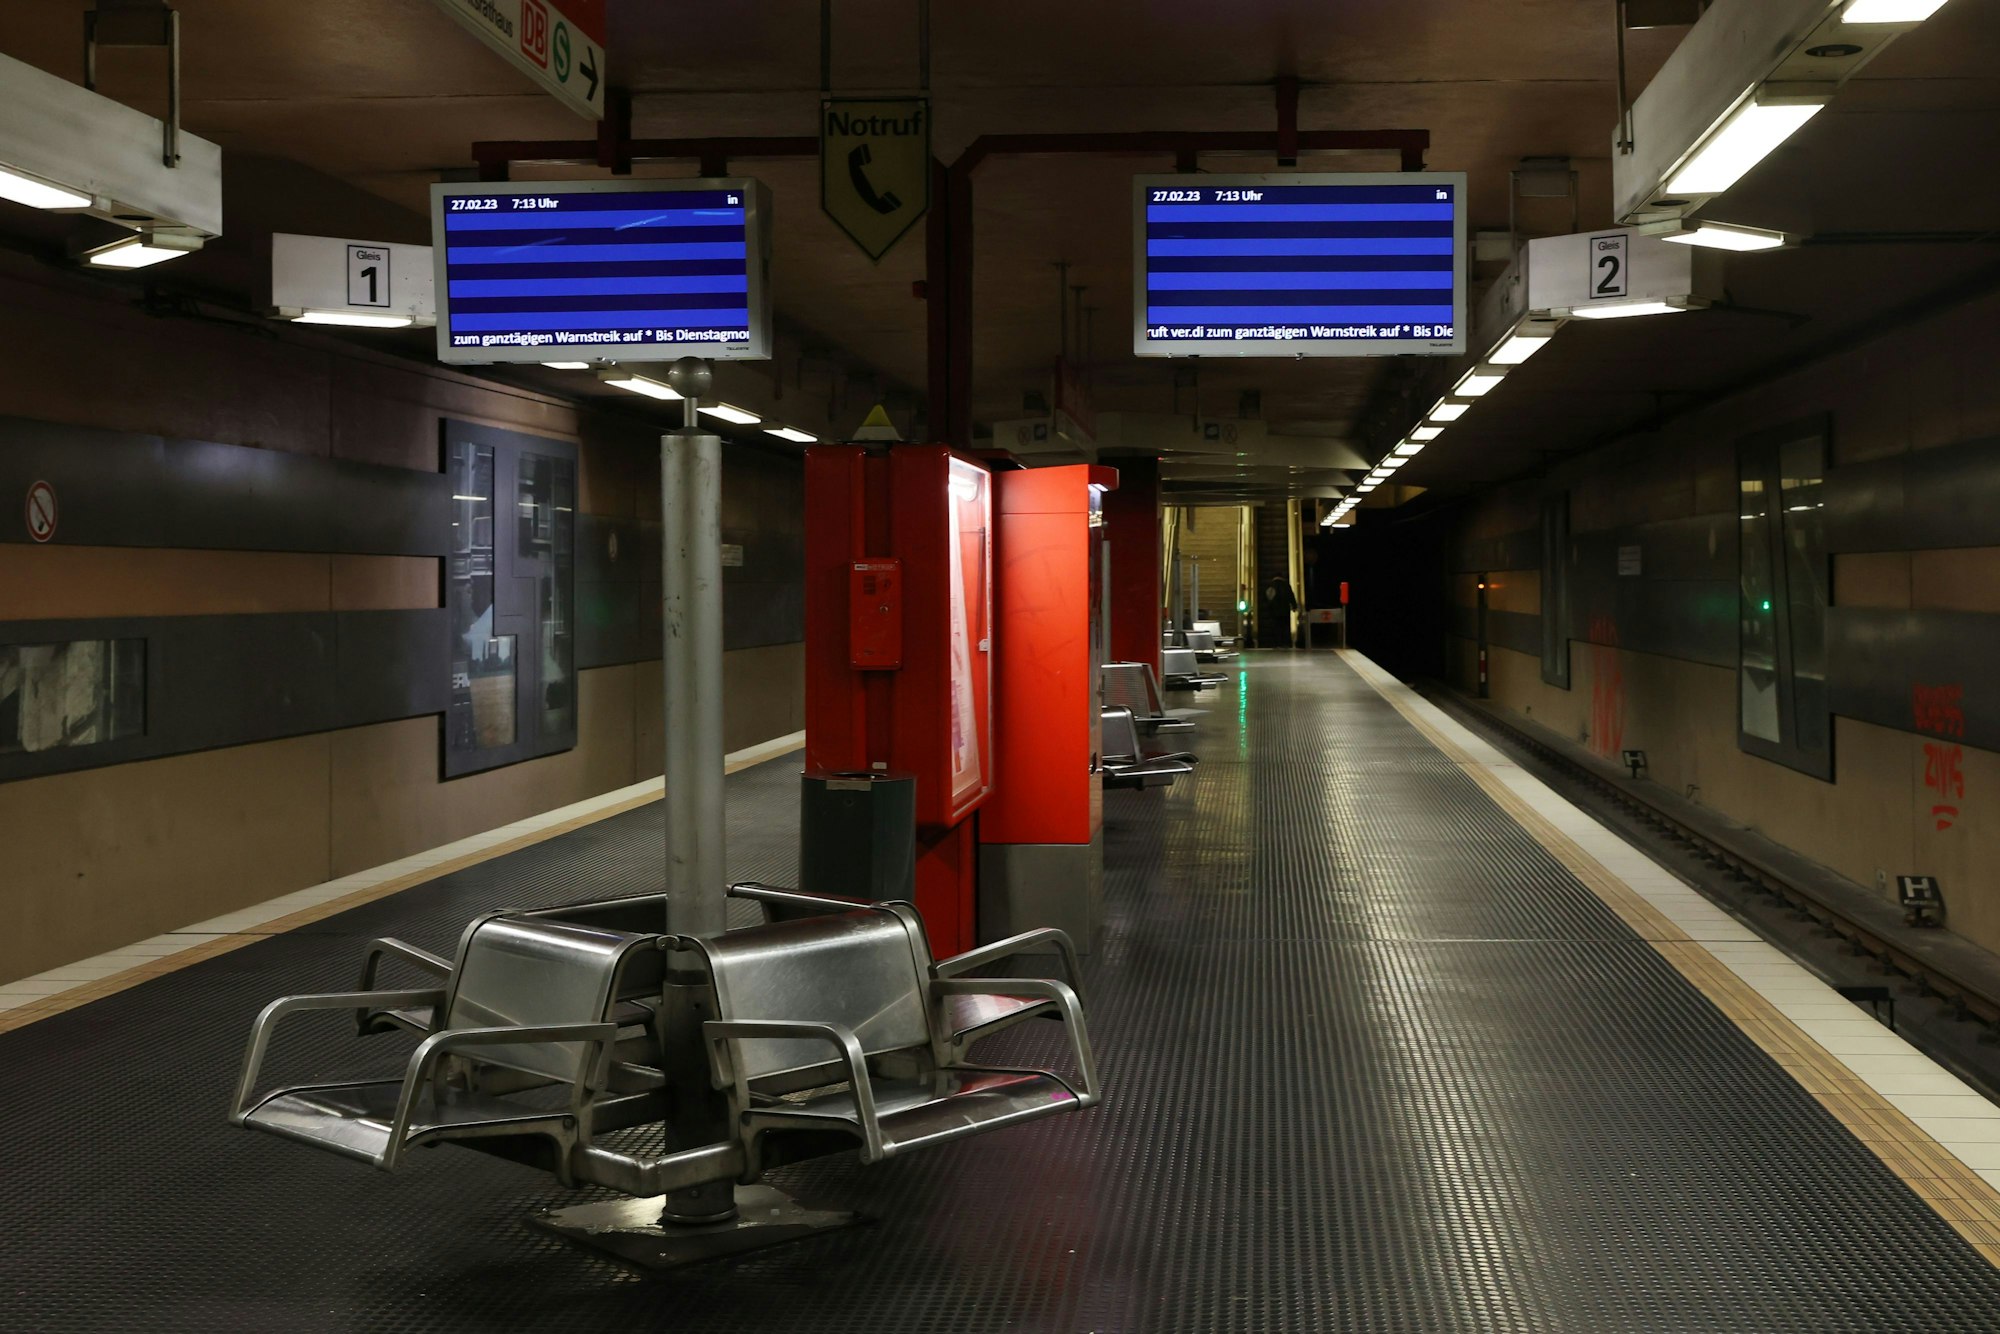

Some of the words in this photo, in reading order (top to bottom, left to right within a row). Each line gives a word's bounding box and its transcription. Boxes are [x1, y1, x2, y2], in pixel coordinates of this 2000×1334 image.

[523, 0, 546, 59] DB
[828, 111, 923, 137] Notruf
[451, 199, 498, 210] 27.02.23
[512, 199, 536, 209] 7:13
[538, 198, 559, 209] Uhr
[727, 194, 739, 205] in
[1153, 191, 1201, 202] 27.02.23
[1215, 191, 1240, 202] 7:13
[1242, 190, 1263, 201] Uhr
[1436, 189, 1447, 200] in
[1598, 241, 1620, 251] Gleis
[356, 250, 381, 261] Gleis
[1597, 255, 1620, 294] 2
[361, 266, 377, 302] 1
[454, 333, 480, 345] zum
[482, 331, 553, 347] ganztägigen
[555, 330, 621, 343] Warnstreik
[623, 329, 643, 342] auf
[656, 329, 674, 342] Bis
[1170, 325, 1204, 338] ver.di
[1206, 328, 1233, 338] zum
[1235, 325, 1308, 340] ganztägigen
[1310, 325, 1377, 338] Warnstreik
[1379, 325, 1401, 338] auf
[1413, 325, 1432, 338] Bis
[1624, 751, 1645, 767] H
[1904, 876, 1932, 898] H
